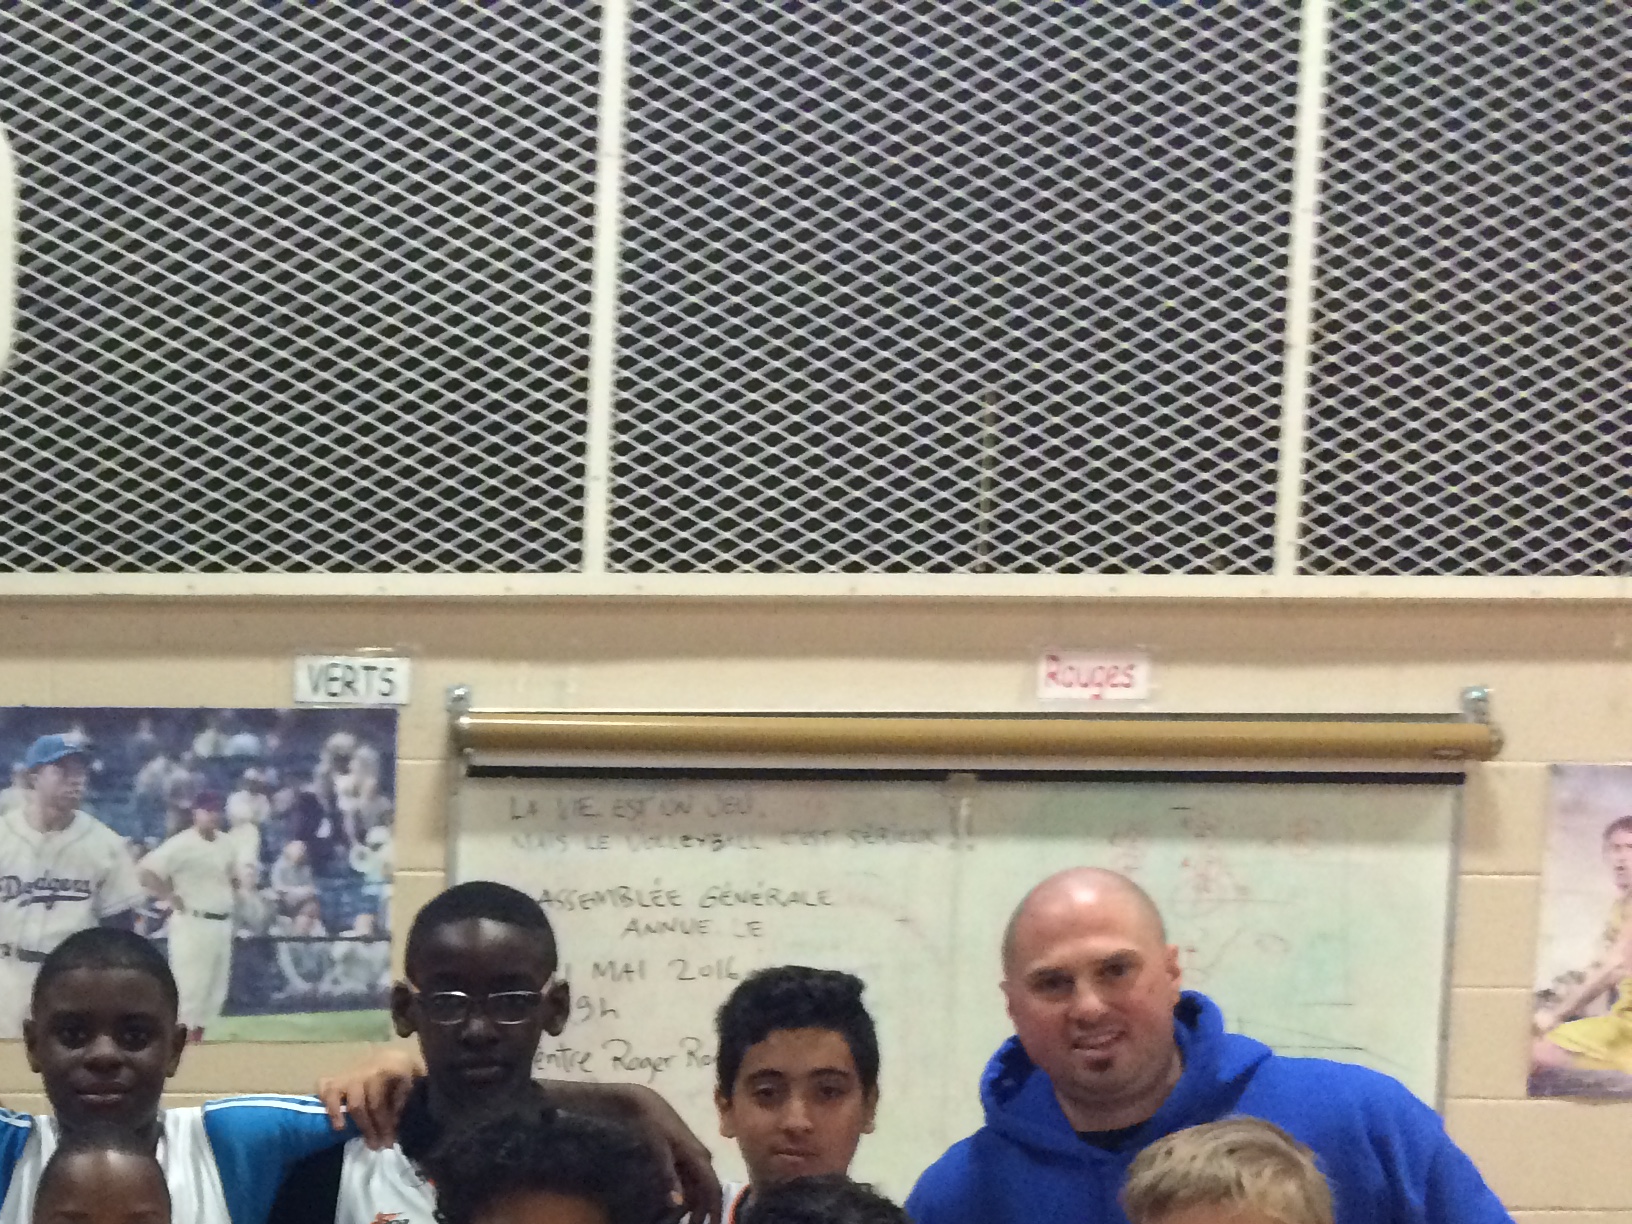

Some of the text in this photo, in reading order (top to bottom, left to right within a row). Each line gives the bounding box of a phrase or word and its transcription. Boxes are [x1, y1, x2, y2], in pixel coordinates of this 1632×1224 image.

[308, 662, 395, 698] VERTS
[1045, 654, 1136, 700] Rouges
[537, 878, 834, 911] ASSEMBLÉE GÉNÉRALE
[591, 960, 647, 982] MAI
[667, 956, 740, 982] 2016
[533, 1044, 594, 1074] entre
[599, 1037, 678, 1084] Roger
